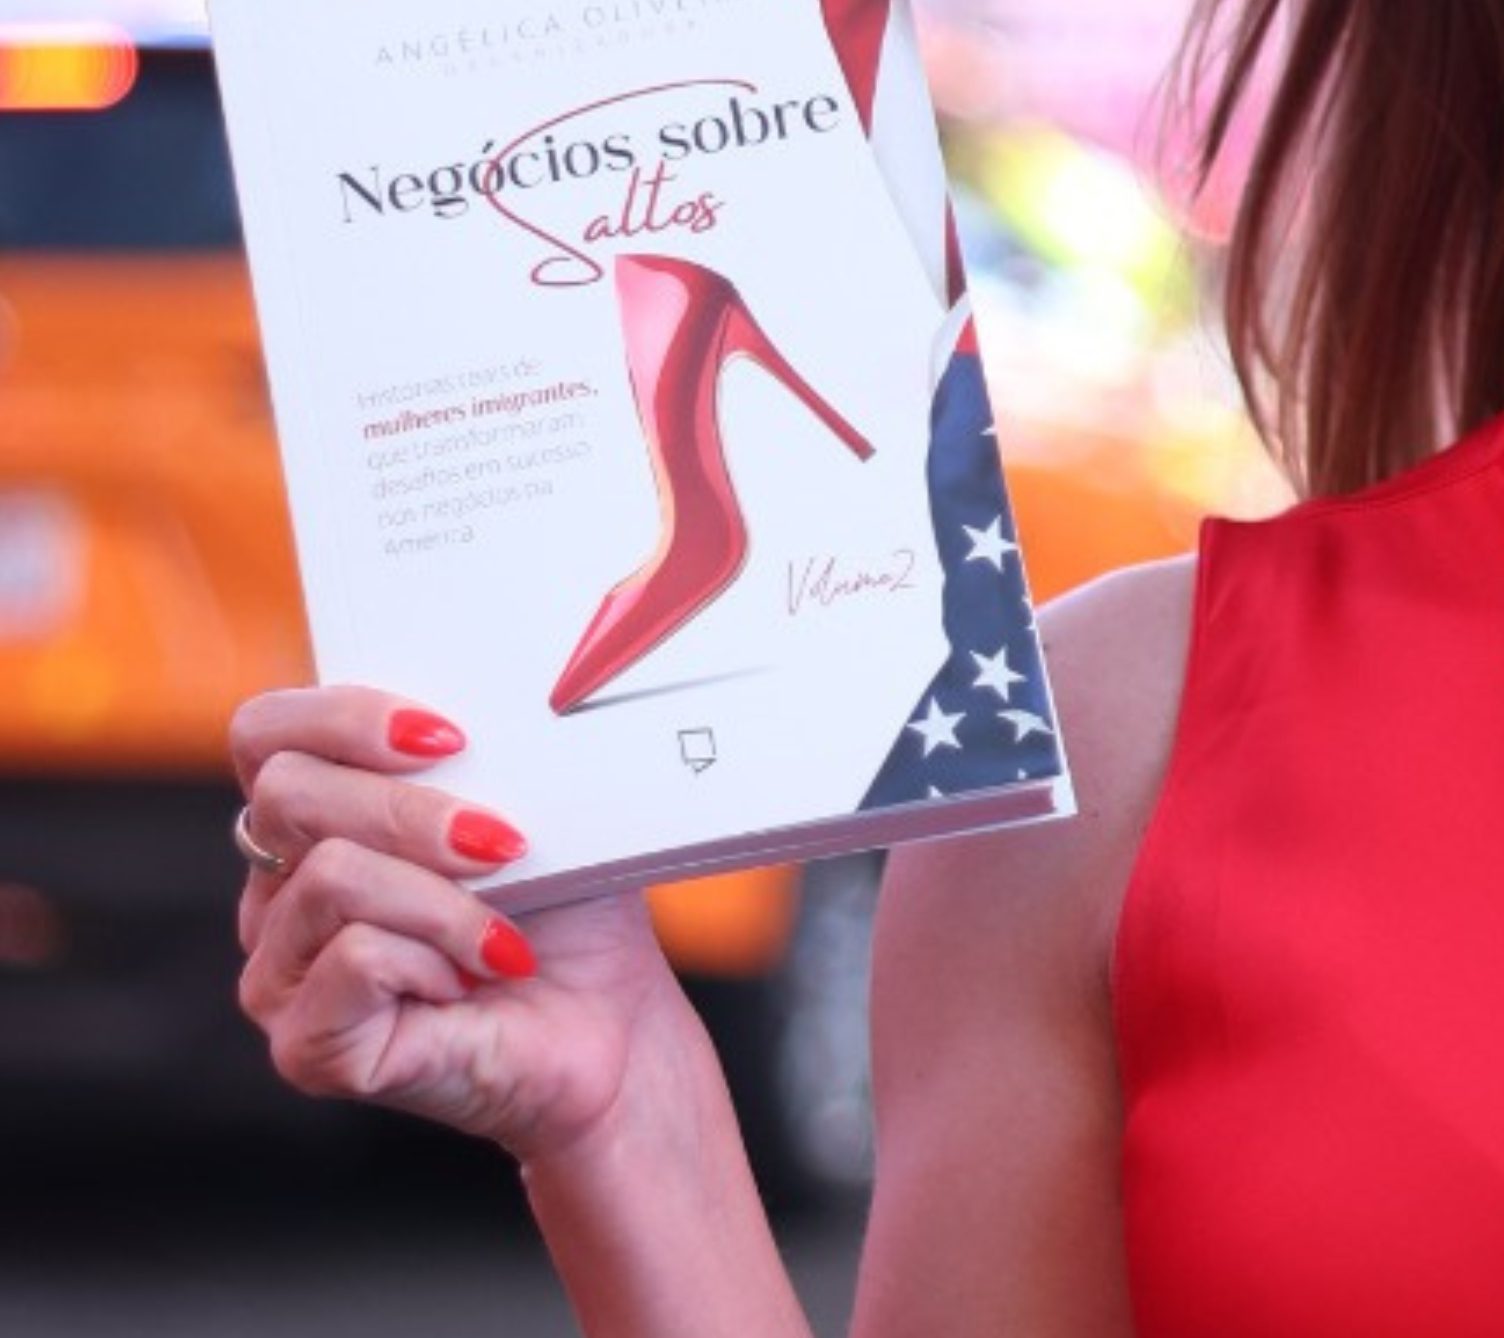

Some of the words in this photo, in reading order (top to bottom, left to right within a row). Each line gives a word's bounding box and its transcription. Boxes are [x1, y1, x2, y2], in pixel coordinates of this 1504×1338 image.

[337, 133, 635, 223] Negócios
[658, 92, 840, 162] sobre
[482, 79, 757, 287] Saltos
[363, 404, 467, 440] mulheres
